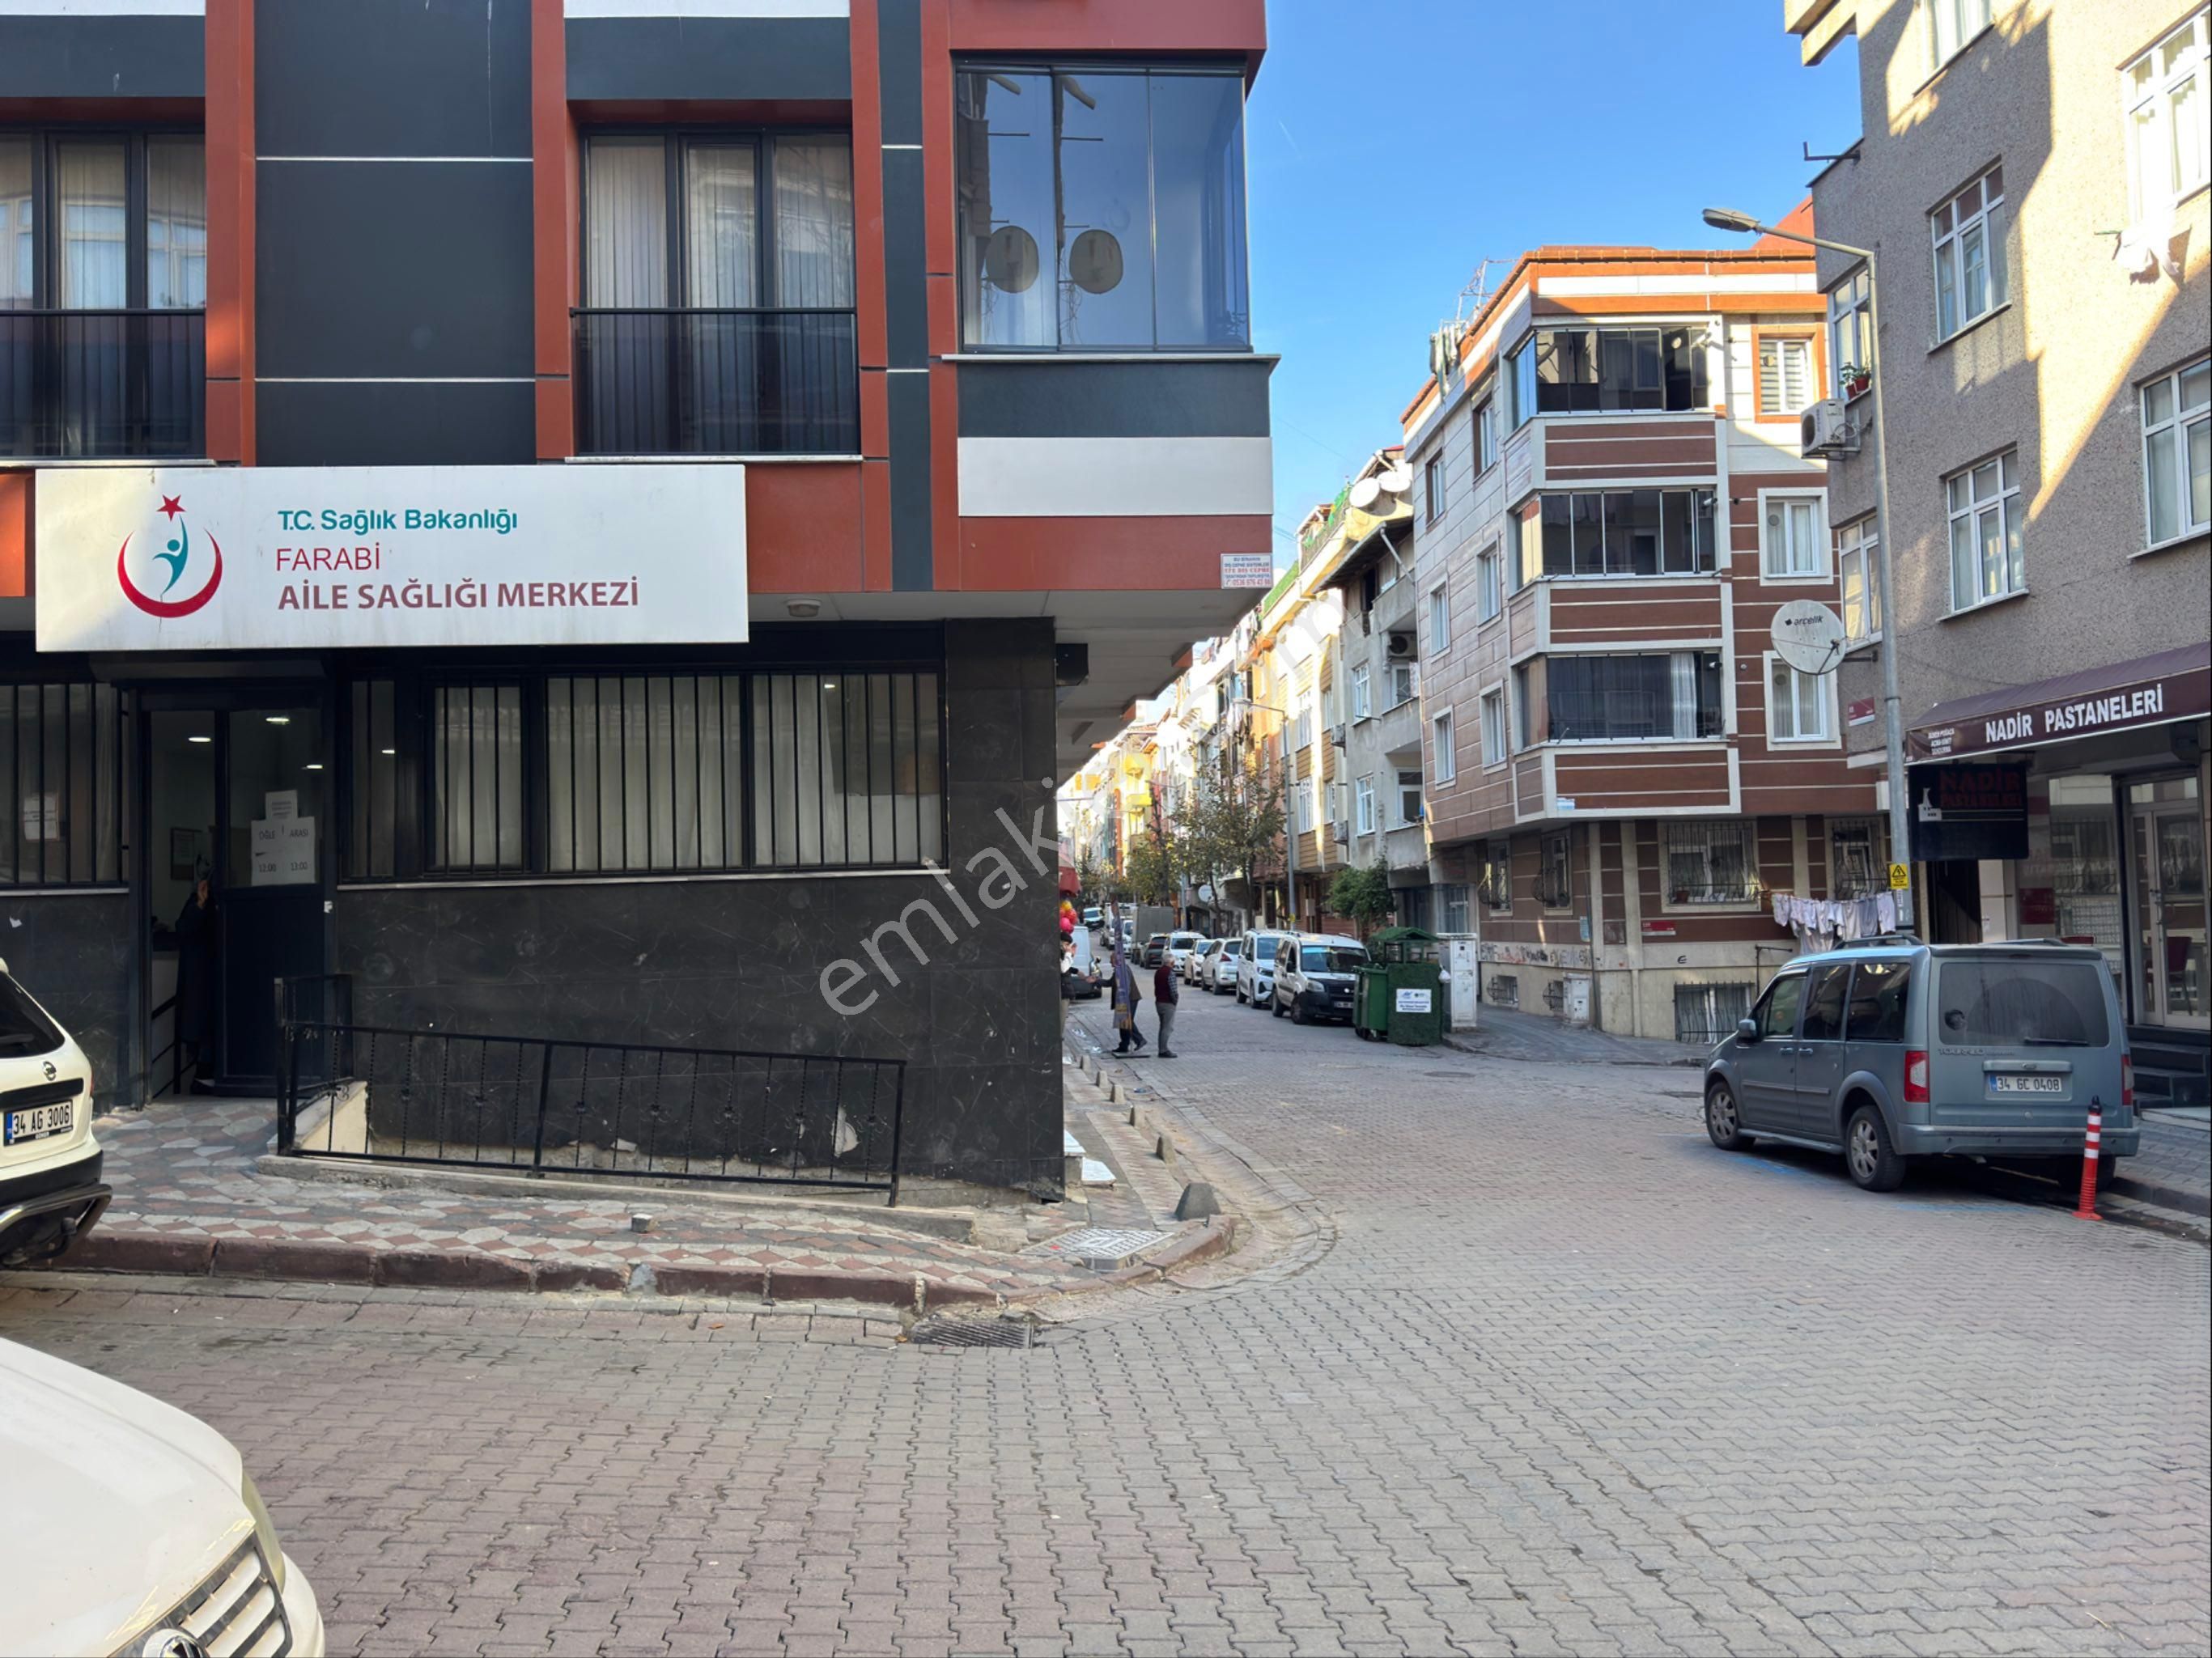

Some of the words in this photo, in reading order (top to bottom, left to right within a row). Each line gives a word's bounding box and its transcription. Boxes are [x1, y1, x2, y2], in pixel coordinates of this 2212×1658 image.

[278, 510, 316, 531] T.C.
[321, 509, 397, 536] Sağlık
[405, 508, 517, 535] Bakanlığı
[277, 541, 380, 571] FARABİ
[278, 579, 349, 610] AİLE
[359, 577, 487, 609] SAĞLIĞI
[498, 577, 639, 608] MERKEZİ
[1985, 712, 2033, 743] NADİR
[2044, 683, 2163, 733] PASTANELERİ
[1998, 1078, 2010, 1090] 34
[2016, 1078, 2030, 1090] GC
[2033, 1079, 2060, 1091] 0408
[13, 1113, 26, 1134] 34
[31, 1110, 44, 1131] AG
[47, 1105, 70, 1128] 3006
